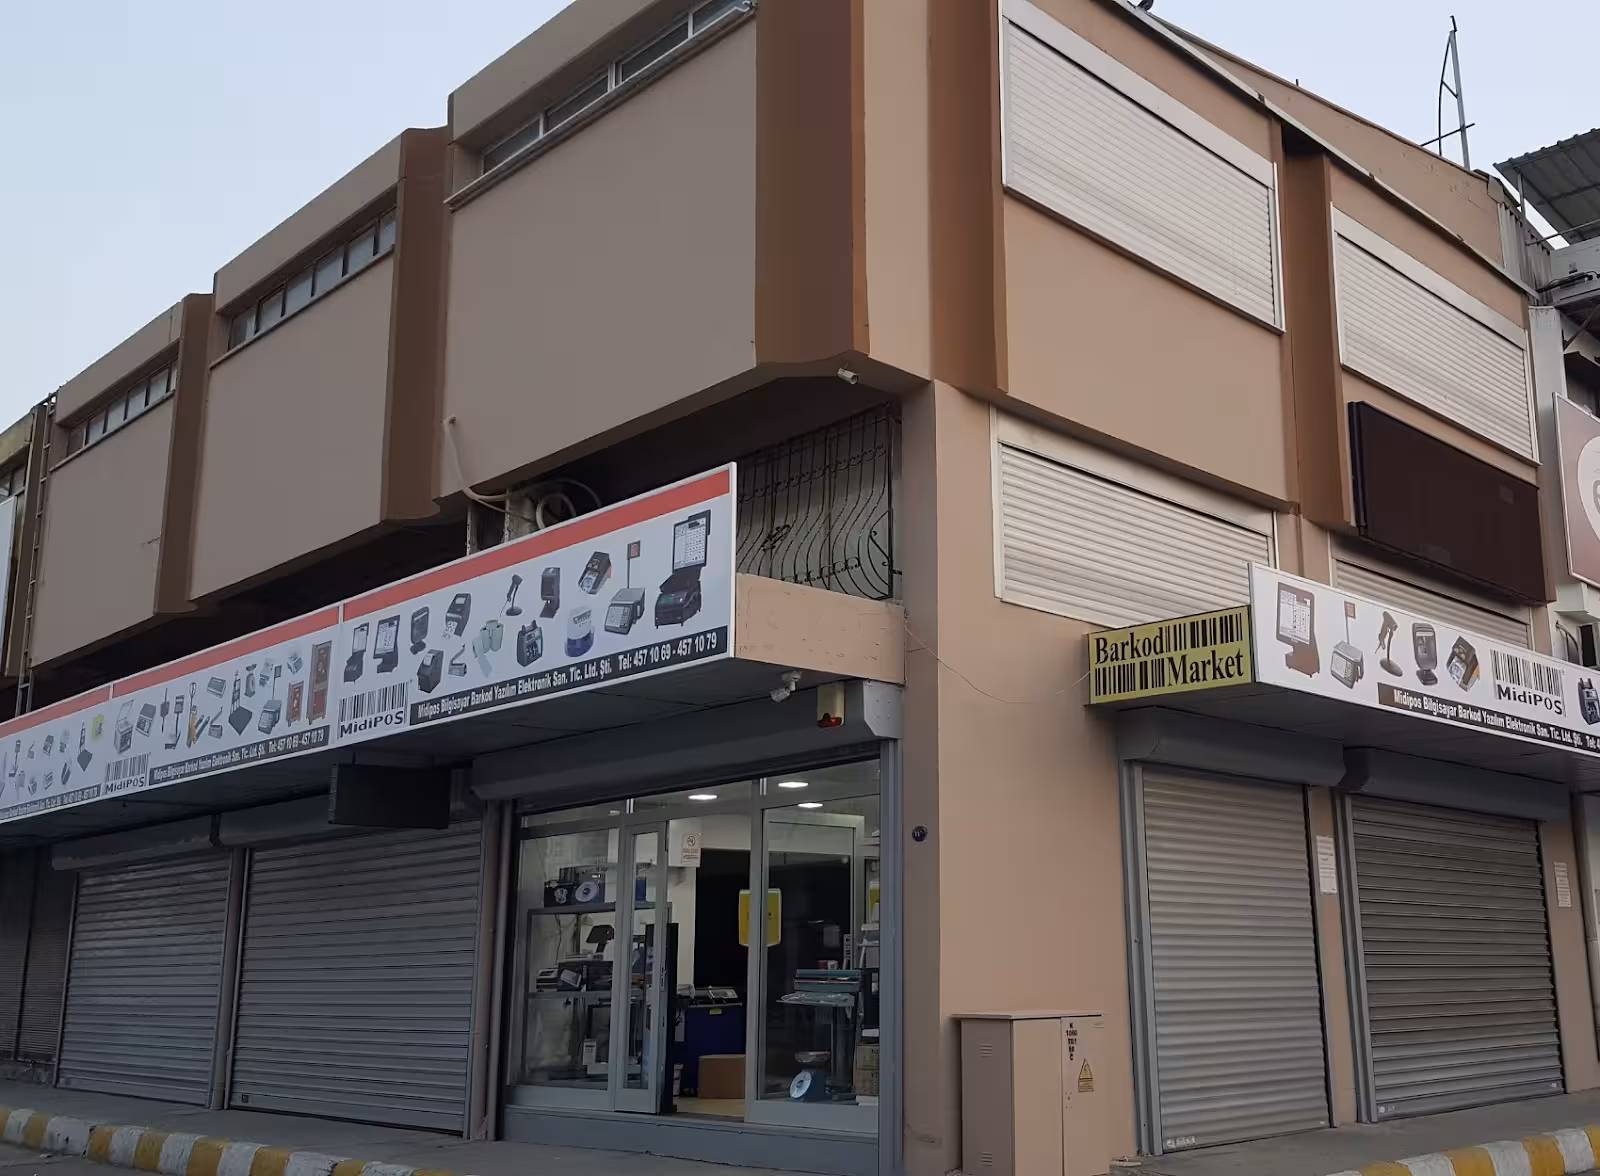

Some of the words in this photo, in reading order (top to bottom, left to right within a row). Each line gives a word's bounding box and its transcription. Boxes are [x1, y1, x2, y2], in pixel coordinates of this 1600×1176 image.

[1095, 626, 1165, 664] Barkod
[471, 687, 493, 706] Barkod
[518, 671, 552, 695] Elektronik
[553, 670, 568, 687] San.
[569, 666, 582, 682] Tic.
[585, 663, 598, 679] Ltd.
[600, 659, 612, 679] Şti.
[618, 653, 632, 671] Tel:
[633, 648, 648, 667] 457
[650, 646, 659, 663] 10
[660, 643, 671, 661] 69
[677, 638, 692, 656] 457
[695, 634, 705, 652] 10
[707, 632, 717, 649] 79
[1167, 648, 1244, 686] Market
[1393, 689, 1422, 709] Midipos
[1422, 696, 1457, 718] Bilgisayar
[1458, 704, 1481, 722] Barkod
[1505, 716, 1536, 735] Elektronik
[1536, 724, 1550, 738] San.
[1549, 727, 1561, 740] Tic.
[1497, 684, 1563, 715] MidiPOS
[340, 711, 404, 738] MidiPOS
[106, 777, 144, 795] MidiPOS
